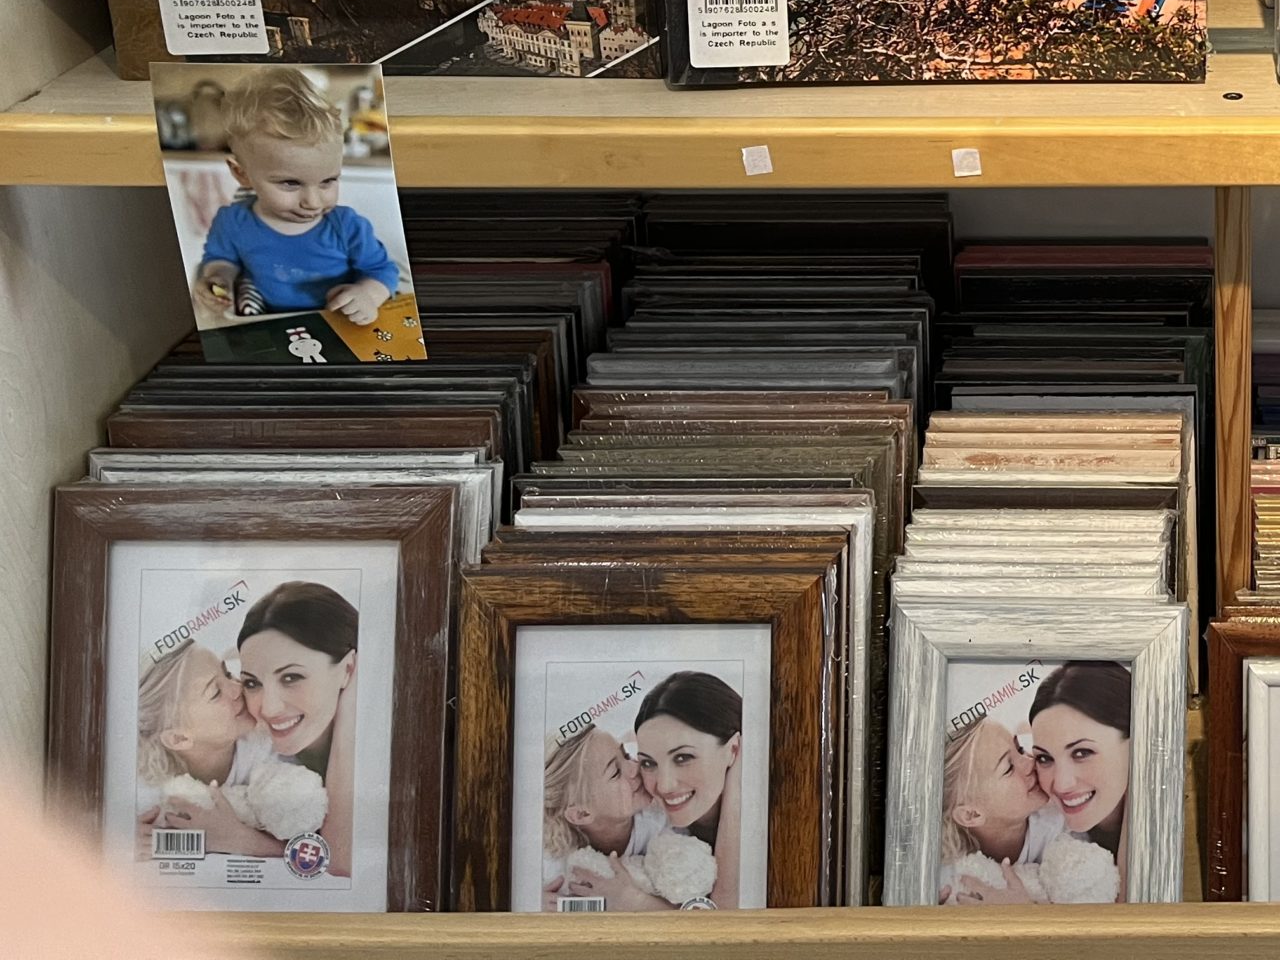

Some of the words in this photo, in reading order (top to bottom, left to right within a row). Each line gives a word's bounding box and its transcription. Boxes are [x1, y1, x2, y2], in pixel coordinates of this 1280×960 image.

[178, 13, 211, 21] Lagoon
[190, 22, 226, 30] importer
[702, 20, 733, 29] Lagoon
[220, 31, 258, 39] Republic
[711, 30, 747, 38] importer
[154, 590, 246, 654] FOTORAMIK.SK
[950, 667, 1041, 732] FOTORAMIK.SK
[558, 679, 642, 739] FOTORAMIK.SK
